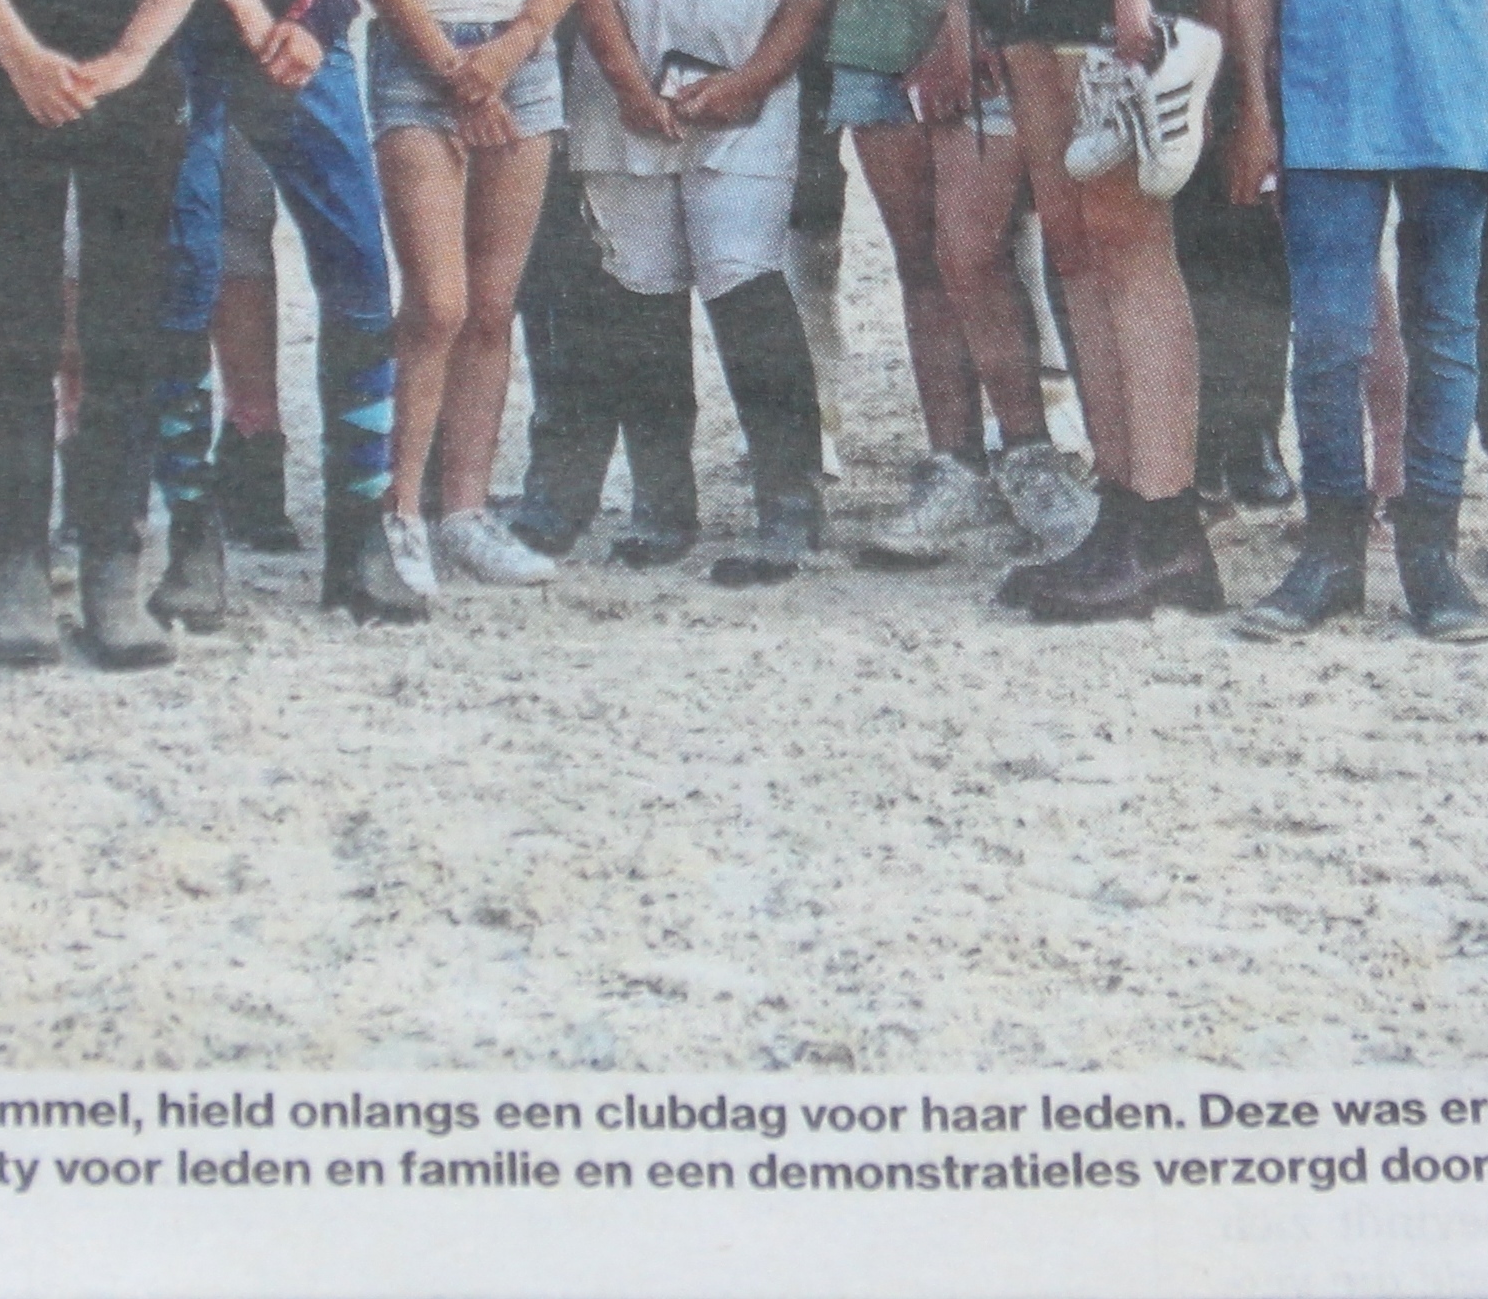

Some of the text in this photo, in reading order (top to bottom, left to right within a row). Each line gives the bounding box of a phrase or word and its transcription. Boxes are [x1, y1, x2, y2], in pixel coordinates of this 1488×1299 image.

[159, 1092, 273, 1127] hield
[290, 1092, 479, 1136] onlangs
[495, 1102, 581, 1128] een
[596, 1094, 786, 1138] clubdag
[802, 1105, 907, 1131] voor
[923, 1096, 1026, 1131] haar
[1042, 1094, 1185, 1130] leden.
[1200, 1093, 1318, 1128] Deze
[1333, 1099, 1426, 1125] was
[55, 1158, 162, 1185] voor
[179, 1150, 310, 1185] leden
[327, 1159, 384, 1185] en
[400, 1150, 560, 1186] familie
[575, 1160, 632, 1187] en
[648, 1161, 733, 1188] een
[749, 1152, 1140, 1190] demonstratieles
[1154, 1147, 1366, 1191] verzorgd
